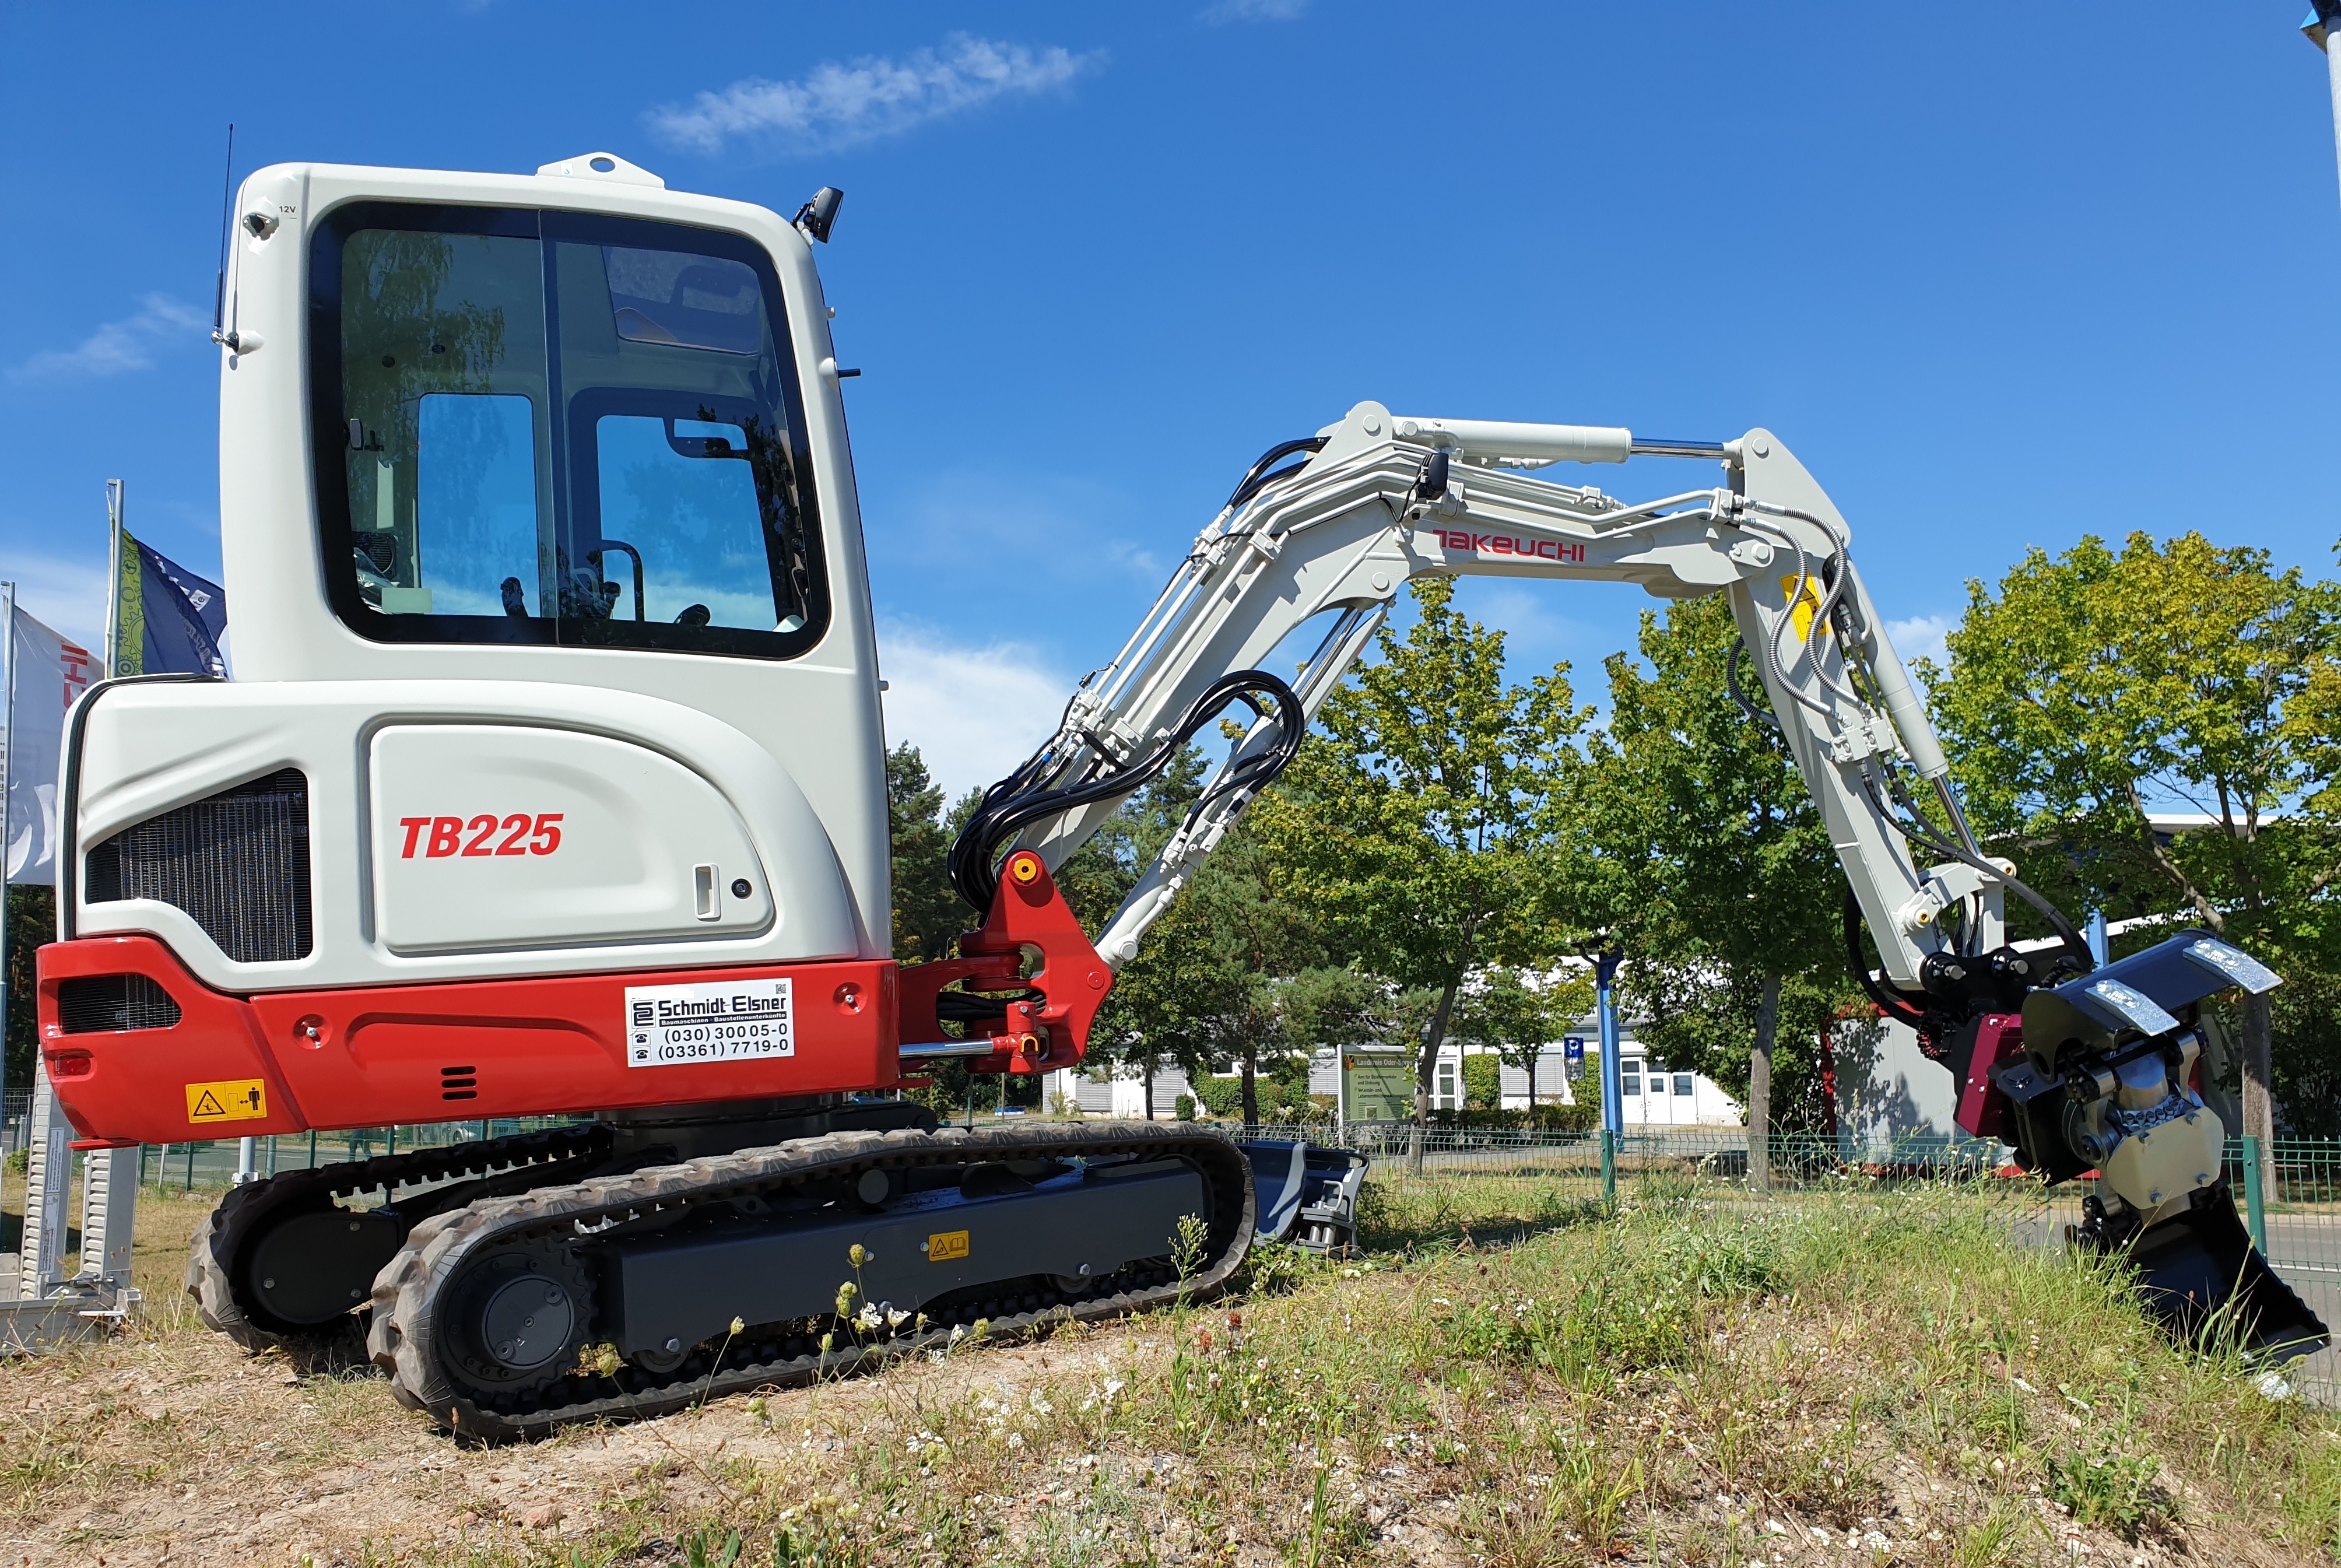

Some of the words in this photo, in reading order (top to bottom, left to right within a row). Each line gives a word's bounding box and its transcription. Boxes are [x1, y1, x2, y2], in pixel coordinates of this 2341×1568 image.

[400, 813, 564, 858] TB225
[665, 1026, 710, 1044] (030)
[659, 1041, 725, 1061] (03361)
[1568, 1040, 1579, 1055] P
